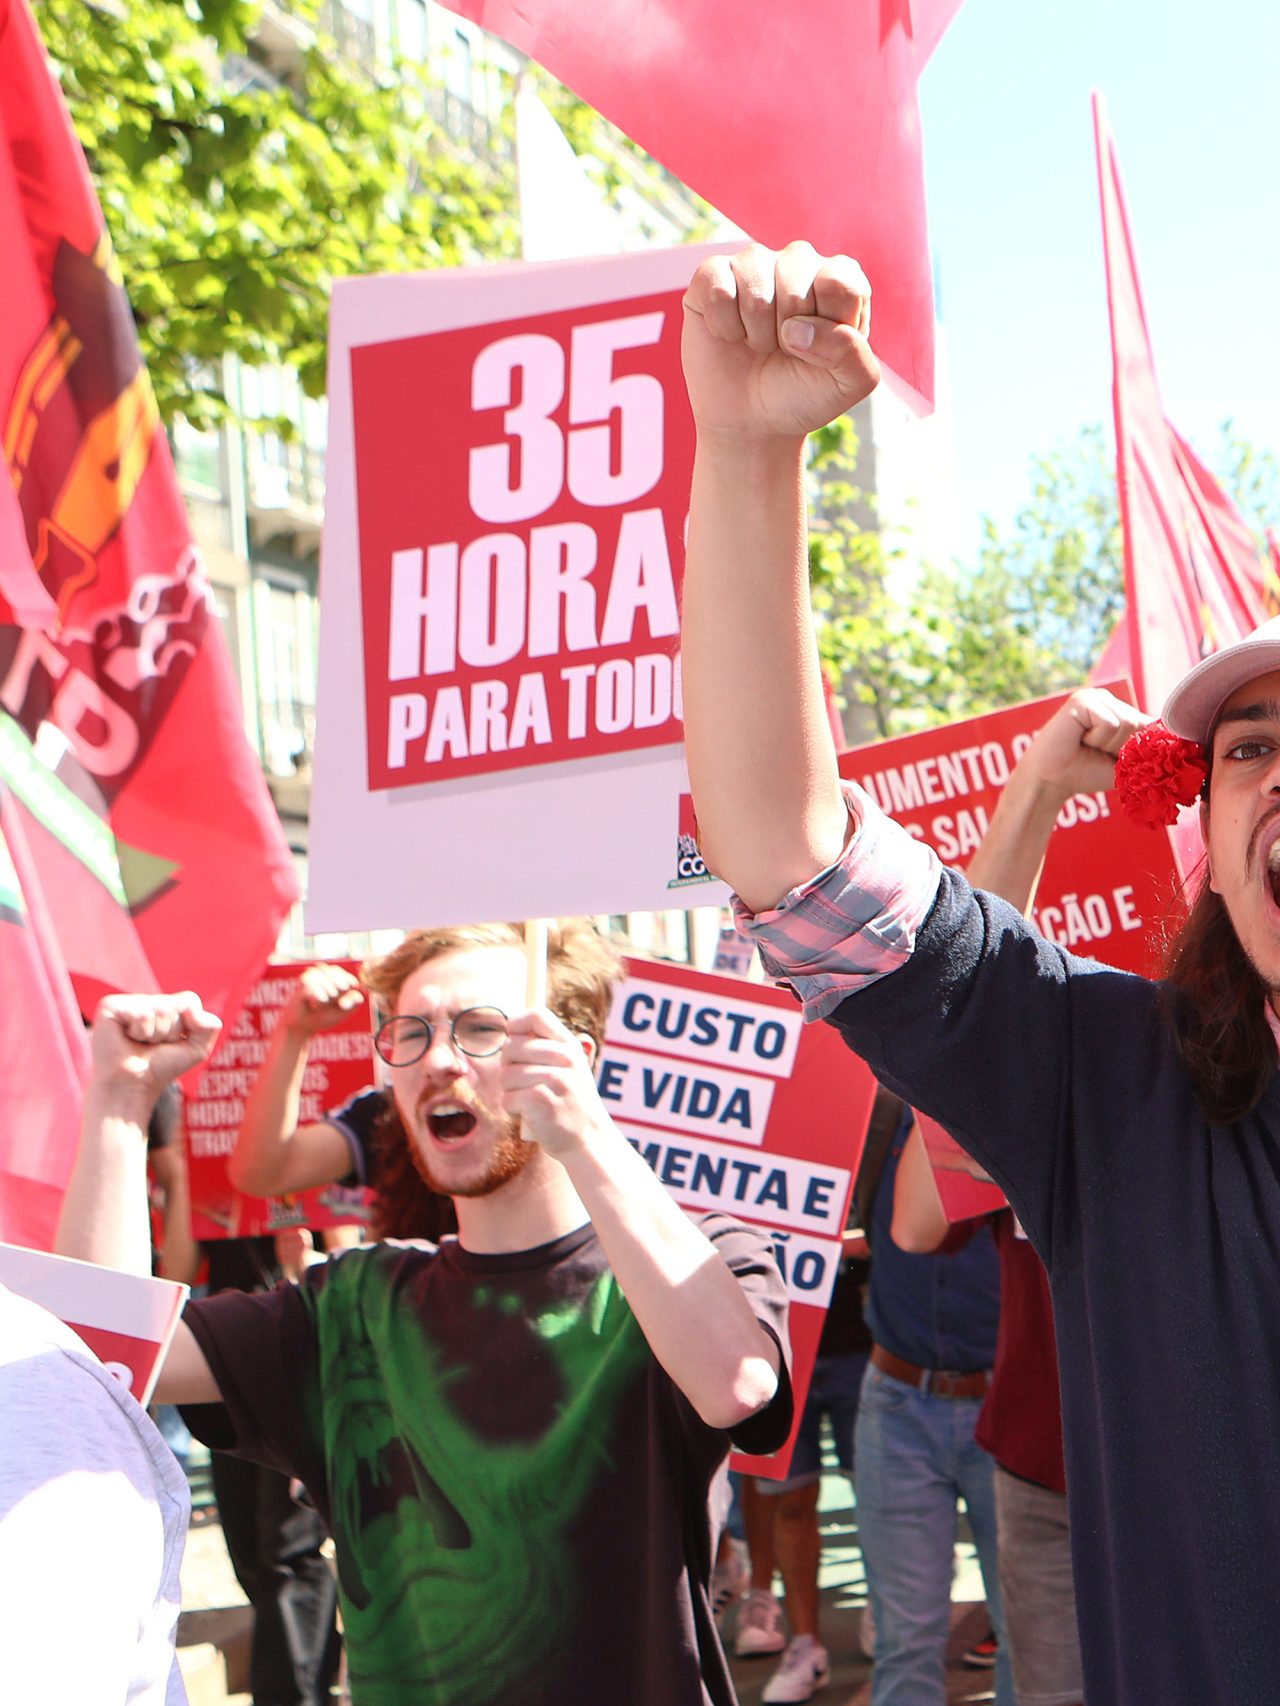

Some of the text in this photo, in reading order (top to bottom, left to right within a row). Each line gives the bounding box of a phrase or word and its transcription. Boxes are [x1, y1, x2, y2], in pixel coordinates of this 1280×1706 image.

[468, 311, 665, 524] 35
[388, 506, 689, 682] HORA
[387, 671, 553, 768] PARA
[857, 742, 1009, 816] UMENTO
[1113, 886, 1142, 931] E
[622, 993, 786, 1060] CUSTO
[596, 1060, 751, 1129] E VIDA
[802, 1176, 835, 1219] E
